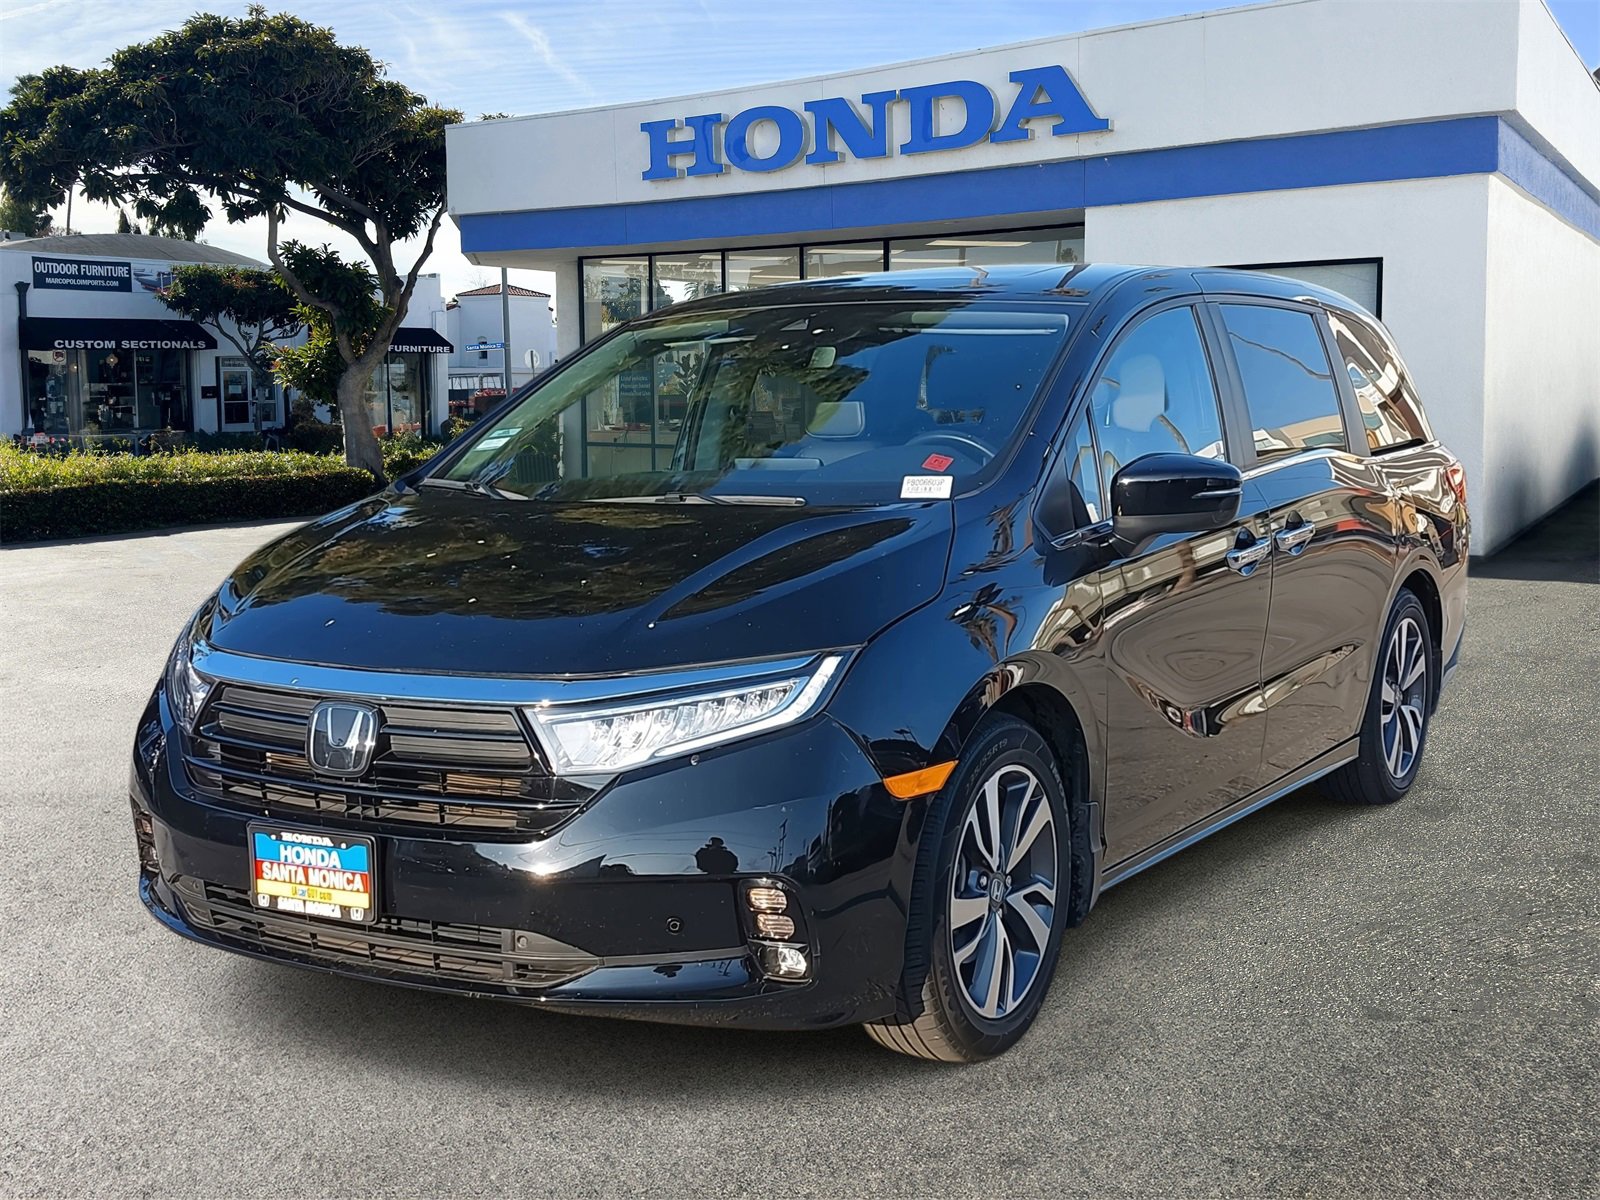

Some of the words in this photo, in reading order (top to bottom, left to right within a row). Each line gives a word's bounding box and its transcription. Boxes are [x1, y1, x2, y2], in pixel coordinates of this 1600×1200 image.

[640, 64, 1113, 181] HONDA
[34, 261, 79, 275] OUTDOOR
[80, 264, 130, 278] FURNITURE
[45, 277, 119, 287] MARCOPOLOIMPORTS.COM
[54, 339, 116, 349] CUSTOM
[121, 340, 206, 349] SECTIONALS
[388, 344, 451, 353] FURNITURE
[280, 831, 334, 847] HONDA
[280, 844, 342, 870] HONDA
[263, 861, 306, 884] SANTA
[308, 866, 364, 892] MONICA
